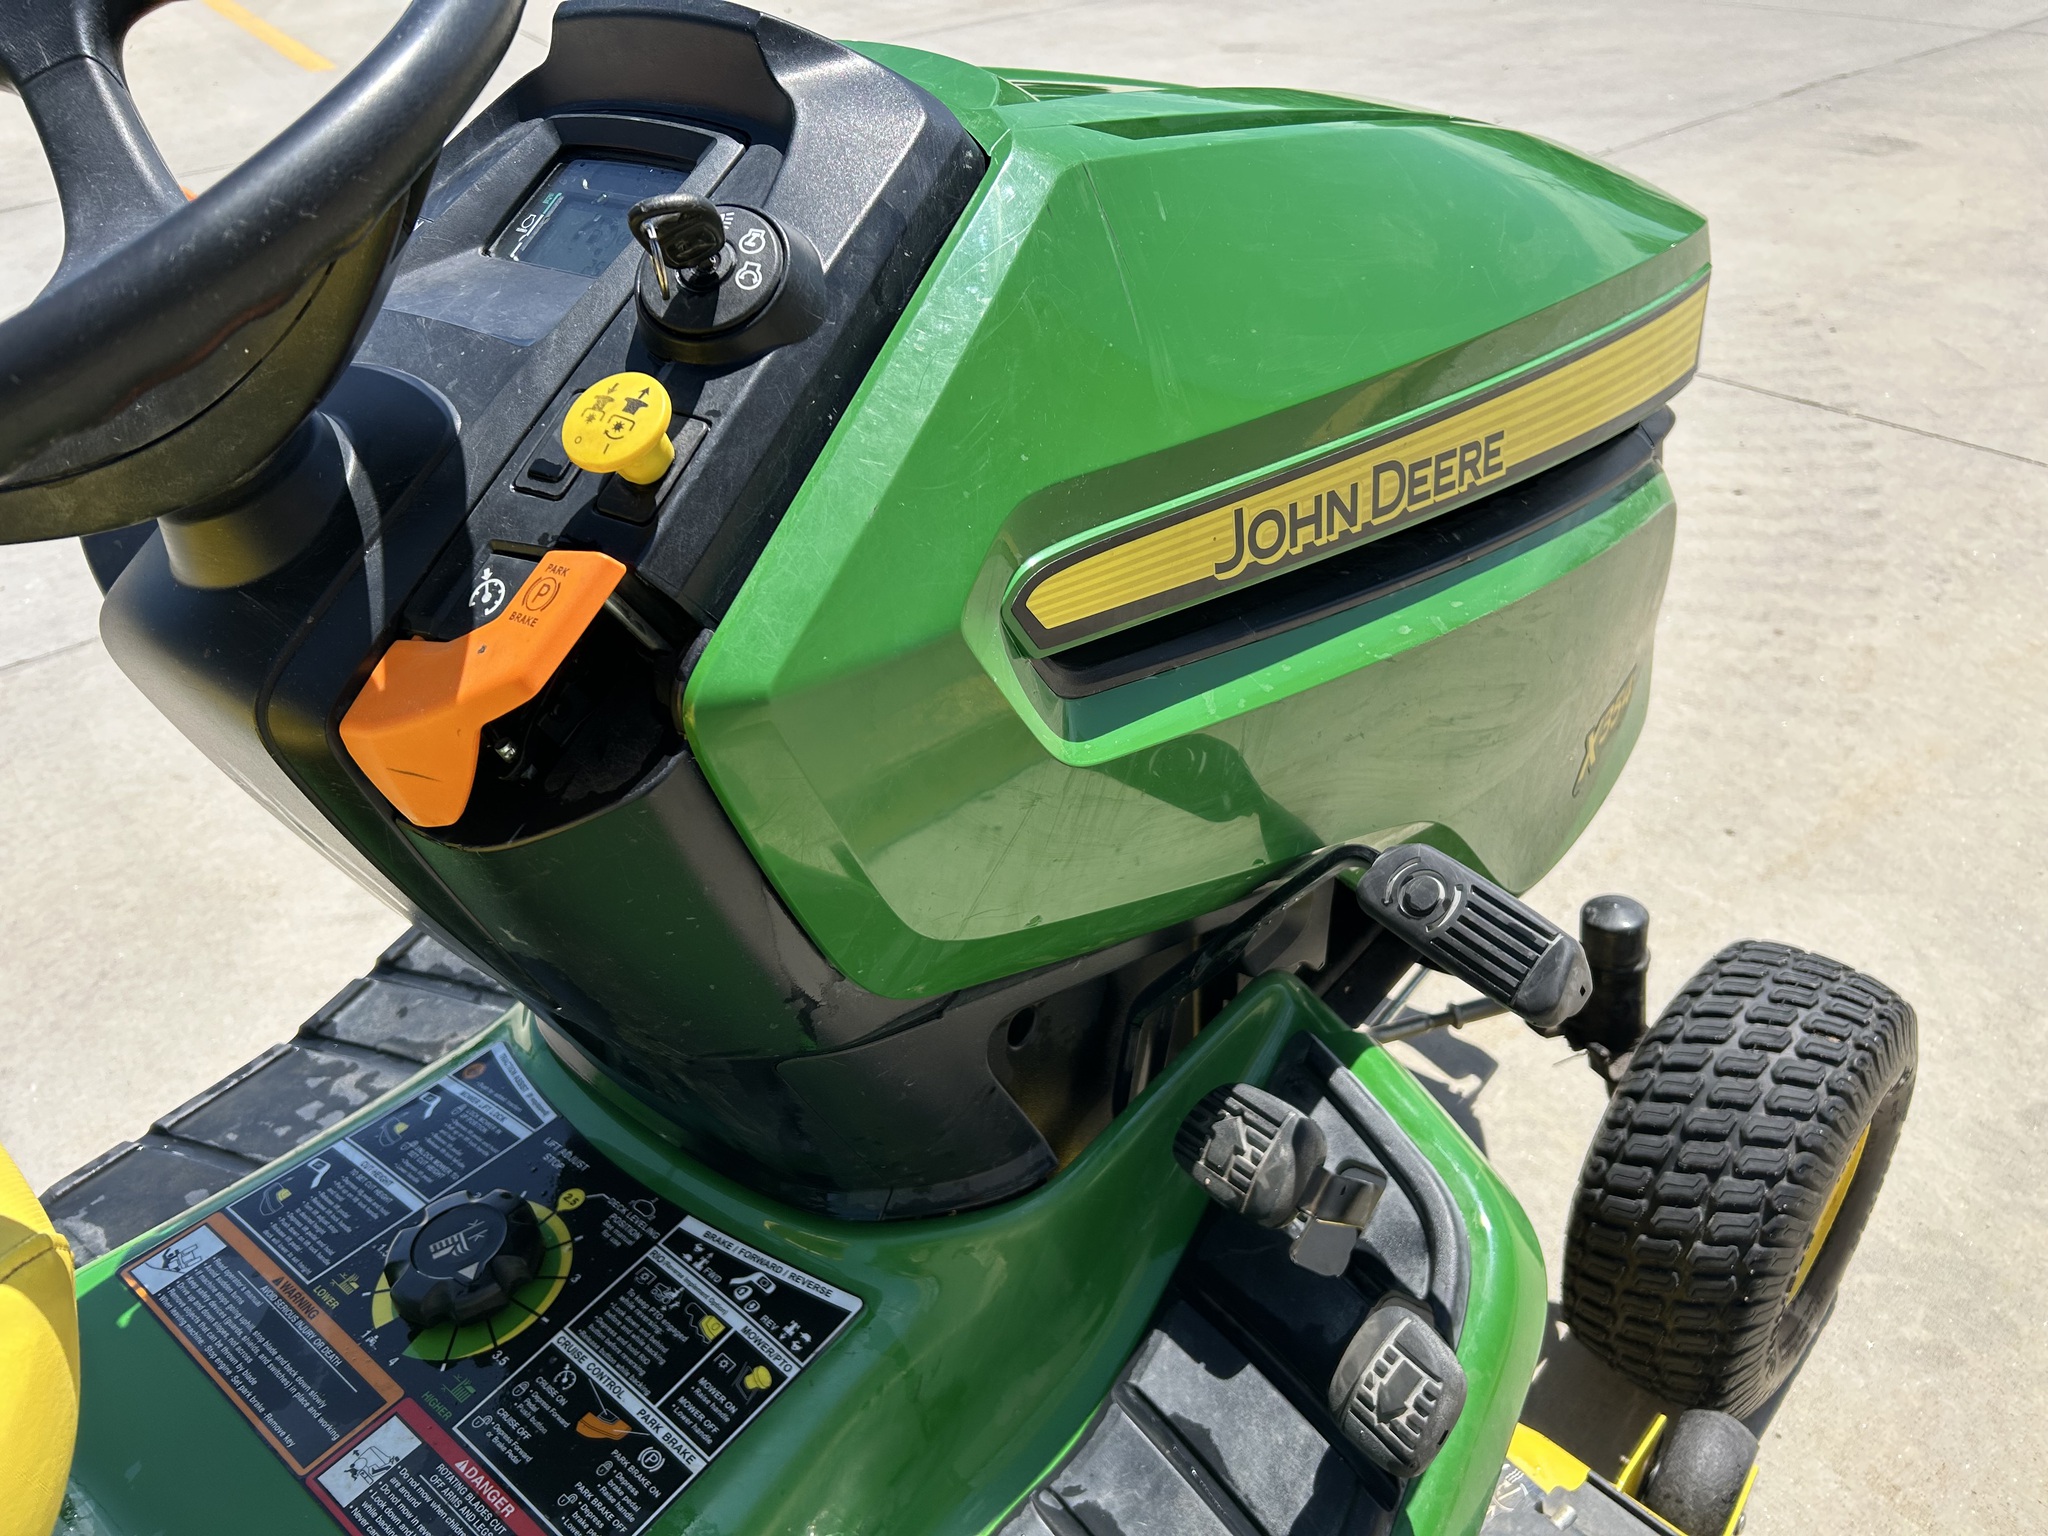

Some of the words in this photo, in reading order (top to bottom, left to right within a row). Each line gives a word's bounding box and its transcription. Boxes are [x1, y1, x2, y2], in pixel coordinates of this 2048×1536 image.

[1214, 482, 1359, 575] JOHN
[1372, 430, 1505, 521] DEERE
[545, 563, 571, 578] PARK
[508, 611, 539, 628] BRAKE
[563, 1193, 580, 1207] 2.5
[650, 1250, 666, 1263] RIO
[701, 1266, 723, 1284] FWD
[702, 1230, 735, 1249] BRAKE
[737, 1247, 785, 1273] FORWARD
[786, 1271, 835, 1298] REVERSE
[203, 1264, 219, 1277] Avoid
[215, 1275, 233, 1292] sudden
[229, 1291, 245, 1304] turns
[213, 1258, 226, 1270] Read
[222, 1267, 247, 1291] operator's
[243, 1288, 263, 1307] manual
[570, 1273, 582, 1284] 3
[278, 1281, 320, 1320] WARNING
[312, 1285, 340, 1311] LOWER
[166, 1288, 187, 1308] Remove
[182, 1305, 202, 1324] objects
[197, 1321, 210, 1333] that
[205, 1330, 218, 1342] can
[213, 1339, 224, 1349] be
[219, 1346, 239, 1365] thrown
[234, 1362, 246, 1372] by
[241, 1369, 258, 1385] blade
[176, 1282, 190, 1295] Drive
[185, 1292, 197, 1302] up
[192, 1299, 205, 1310] and
[200, 1308, 216, 1323] down
[211, 1320, 231, 1339] slopes,
[226, 1336, 239, 1347] not
[234, 1345, 254, 1363] across
[197, 1273, 218, 1293] machine
[213, 1290, 230, 1305] stops
[225, 1303, 242, 1318] going
[237, 1316, 255, 1332] uphill,
[251, 1330, 266, 1344] stop
[261, 1341, 278, 1357] blade
[273, 1354, 288, 1367] and
[282, 1363, 298, 1378] back
[293, 1375, 312, 1392] down
[306, 1389, 327, 1409] slowly
[259, 1284, 278, 1301] AVOID
[273, 1298, 299, 1322] SERIOUS
[294, 1320, 316, 1340] INJURY
[312, 1338, 325, 1349] OR
[320, 1346, 342, 1366] DEATH
[758, 1313, 780, 1332] REV
[184, 1276, 199, 1289] Keep
[194, 1287, 212, 1302] safety
[207, 1300, 227, 1319] devices
[222, 1316, 244, 1337] (guards,
[239, 1335, 261, 1356] shields,
[256, 1353, 270, 1365] and
[265, 1362, 292, 1389] switches)
[286, 1385, 297, 1394] in
[292, 1391, 311, 1409] place
[305, 1405, 321, 1419] and
[315, 1416, 340, 1441] working
[388, 1357, 400, 1367] 4
[491, 1350, 510, 1367] 3.5
[556, 1335, 587, 1363] CRUISE
[586, 1363, 625, 1399] CONTROL
[740, 1325, 793, 1374] MOWER/PTO
[156, 1294, 173, 1310] When
[168, 1307, 187, 1326] leaving
[182, 1323, 206, 1347] machine:
[201, 1344, 218, 1360] -Stop
[212, 1357, 232, 1376] engine
[227, 1373, 242, 1387] -Set
[236, 1384, 253, 1399] park
[247, 1396, 266, 1414] brake
[261, 1411, 287, 1437] -Remove
[281, 1433, 296, 1448] key
[421, 1390, 453, 1422] HIGHER
[523, 1397, 539, 1412] Pedal
[535, 1375, 558, 1397] CRUISE
[554, 1394, 567, 1406] ON
[693, 1387, 712, 1405] Raise
[709, 1402, 731, 1423] handle
[697, 1376, 727, 1403] MOWER
[723, 1400, 738, 1414] ON
[496, 1407, 519, 1429] CRUISE
[516, 1426, 531, 1441] OFF
[516, 1403, 532, 1419] Push
[529, 1415, 548, 1434] button
[530, 1391, 551, 1410] Depress
[548, 1407, 570, 1428] Forward
[673, 1406, 693, 1426] Lower
[691, 1423, 713, 1445] handle
[677, 1395, 705, 1421] MOWER
[702, 1418, 719, 1435] OFF
[485, 1430, 494, 1438] or
[491, 1435, 508, 1452] Brake
[504, 1448, 521, 1464] Pedal
[492, 1423, 513, 1444] Depress
[510, 1441, 532, 1462] Forward
[635, 1408, 662, 1434] PARK
[661, 1432, 696, 1464] BRAKE
[610, 1448, 630, 1468] PARK
[626, 1464, 651, 1488] BRAKE
[648, 1485, 661, 1497] ON
[613, 1472, 639, 1496] Depress
[360, 1500, 379, 1518] while
[369, 1491, 388, 1509] Look
[382, 1506, 403, 1525] down
[378, 1483, 392, 1495] Do
[387, 1492, 401, 1505] not
[396, 1502, 415, 1519] mow
[409, 1516, 420, 1525] in
[389, 1476, 402, 1488] are
[398, 1485, 421, 1508] around
[397, 1467, 411, 1479] Do
[406, 1476, 420, 1489] not
[415, 1485, 433, 1503] mow
[428, 1500, 449, 1519] when
[428, 1474, 445, 1489] OFF
[440, 1487, 463, 1508] ARMS
[458, 1505, 477, 1522] AND
[435, 1463, 468, 1495] ROTATING
[463, 1492, 493, 1521] BLADES
[488, 1518, 506, 1535] CUT
[463, 1466, 516, 1518] DANGER
[573, 1481, 593, 1500] PARK
[589, 1496, 614, 1521] BRAKE
[611, 1518, 627, 1534] OFF
[598, 1486, 616, 1504] Raise
[614, 1501, 636, 1523] handle
[606, 1479, 625, 1497] brake
[622, 1494, 641, 1512] pedal
[571, 1511, 590, 1529] brake
[579, 1503, 605, 1529] Depress
